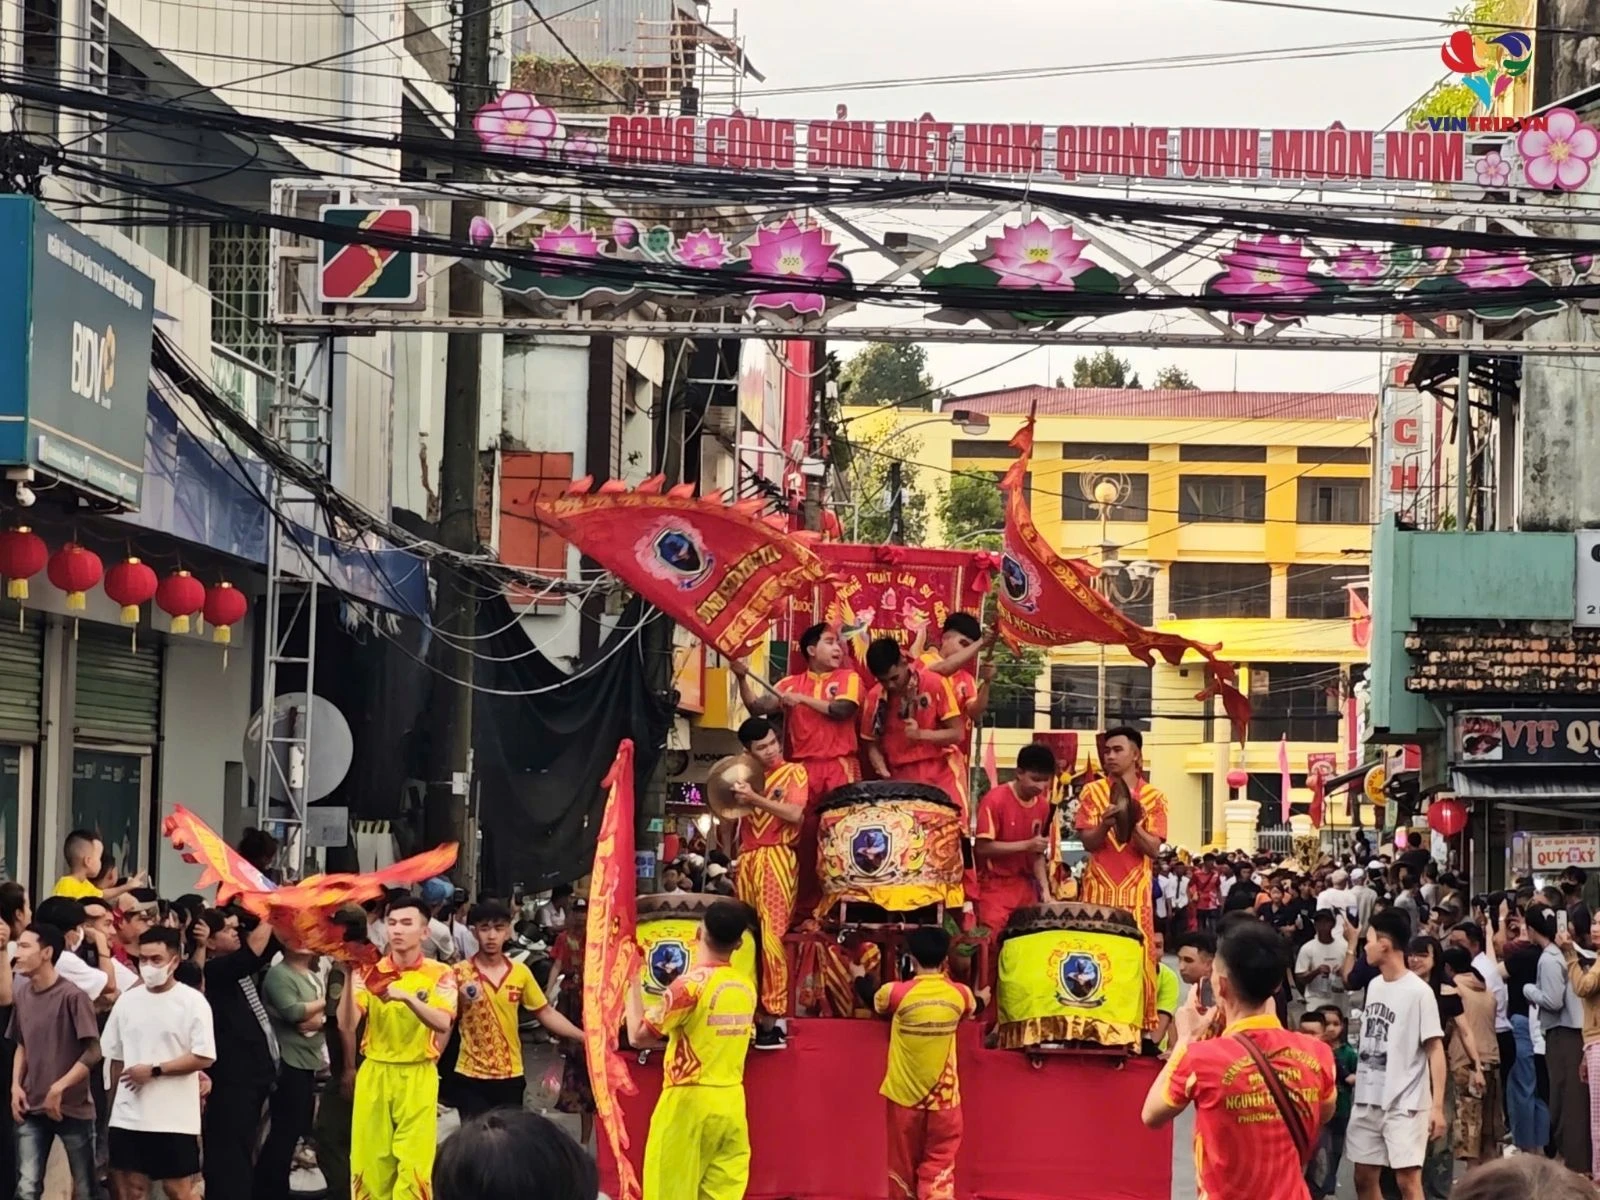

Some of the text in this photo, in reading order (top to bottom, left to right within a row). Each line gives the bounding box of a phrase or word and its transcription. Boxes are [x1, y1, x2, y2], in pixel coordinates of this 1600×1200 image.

[808, 104, 874, 169] SẢN
[886, 112, 953, 181] VIỆT
[964, 123, 1044, 175] NAM
[1057, 125, 1169, 182] QUANG
[1180, 127, 1260, 179] VINH
[1271, 120, 1374, 181] MUÔN
[1385, 122, 1465, 182] NĂM
[71, 320, 106, 404] BIDV
[866, 569, 893, 586] THUẬT
[1501, 719, 1559, 755] VỊT
[1365, 1002, 1396, 1025] STUDIO
